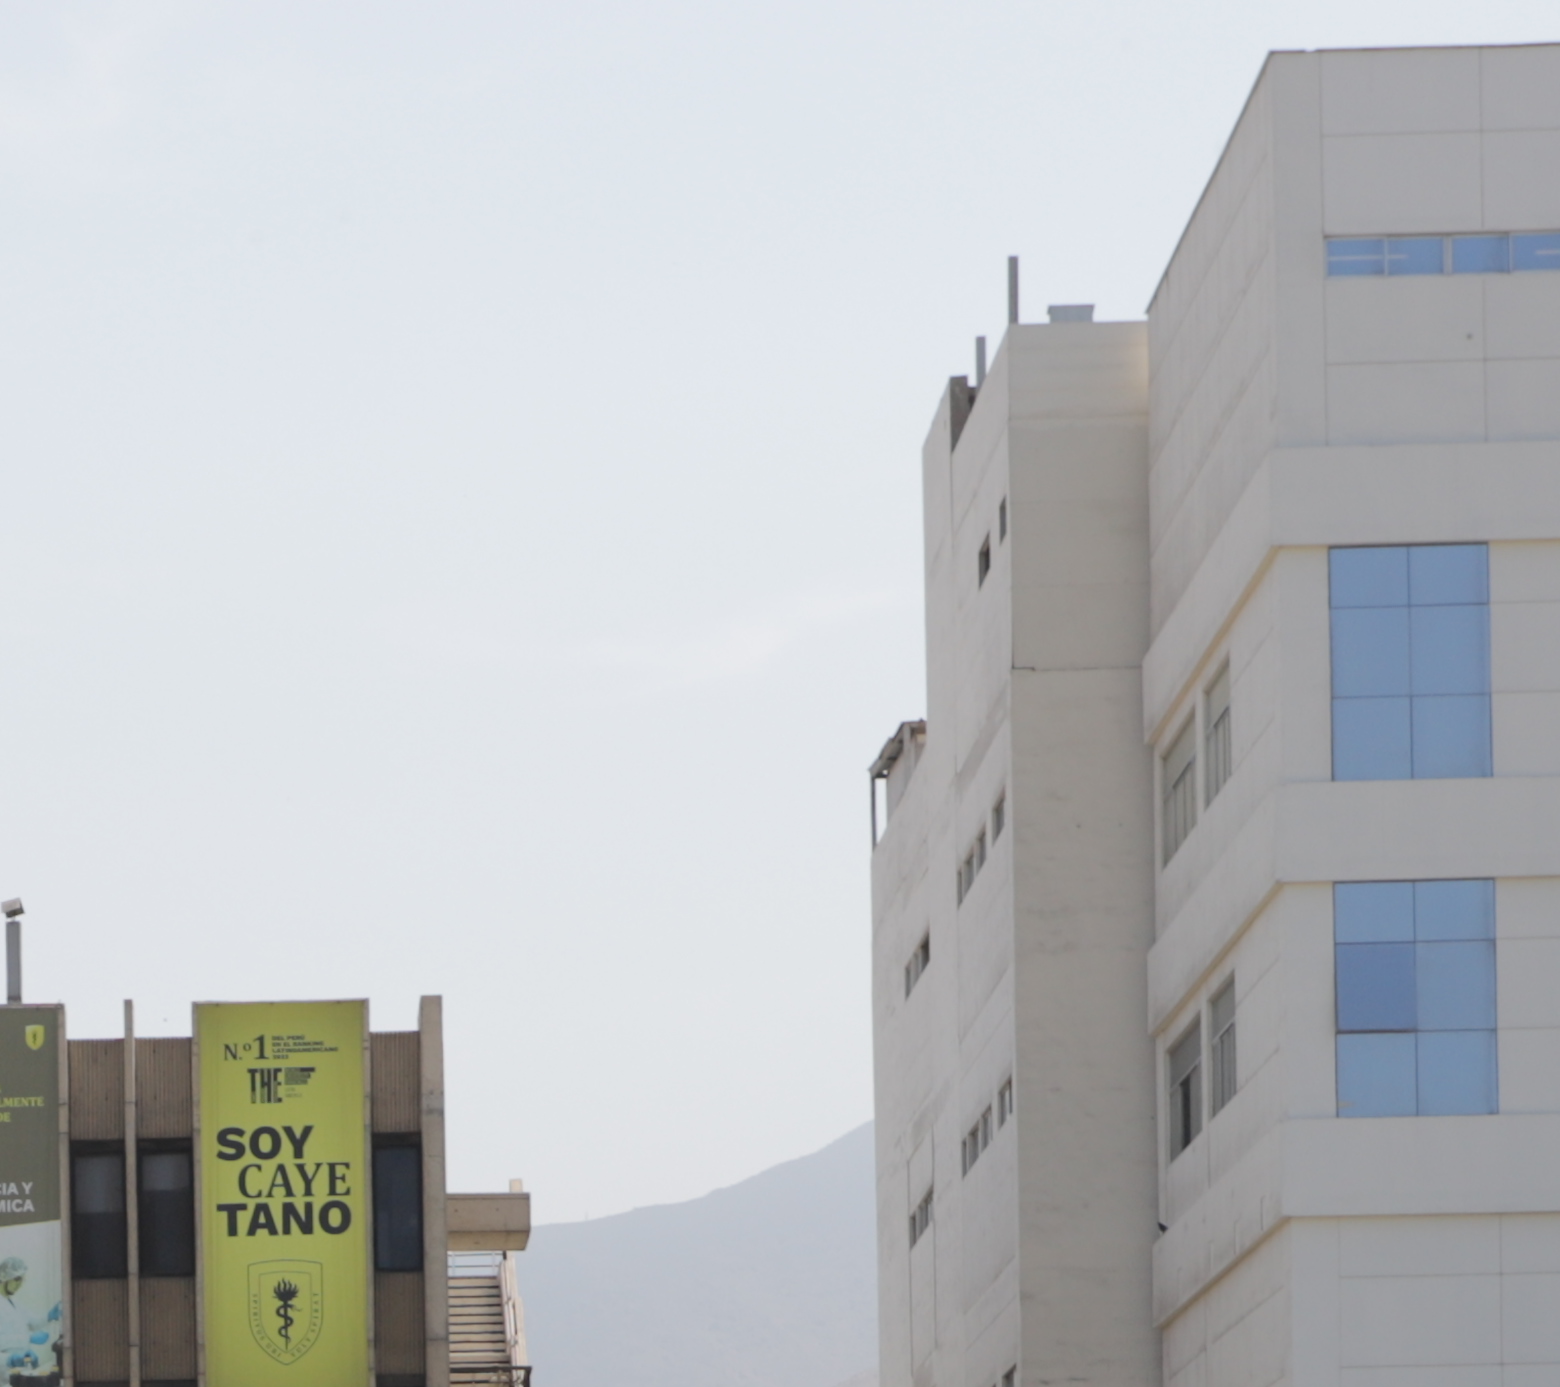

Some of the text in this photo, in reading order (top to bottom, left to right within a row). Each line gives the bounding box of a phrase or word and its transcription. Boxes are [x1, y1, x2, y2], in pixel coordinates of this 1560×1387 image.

[247, 1067, 282, 1104] THE
[216, 1125, 314, 1162] SOY
[21, 1182, 33, 1195] Y
[238, 1161, 352, 1199] CAYE
[216, 1200, 352, 1237] TANO
